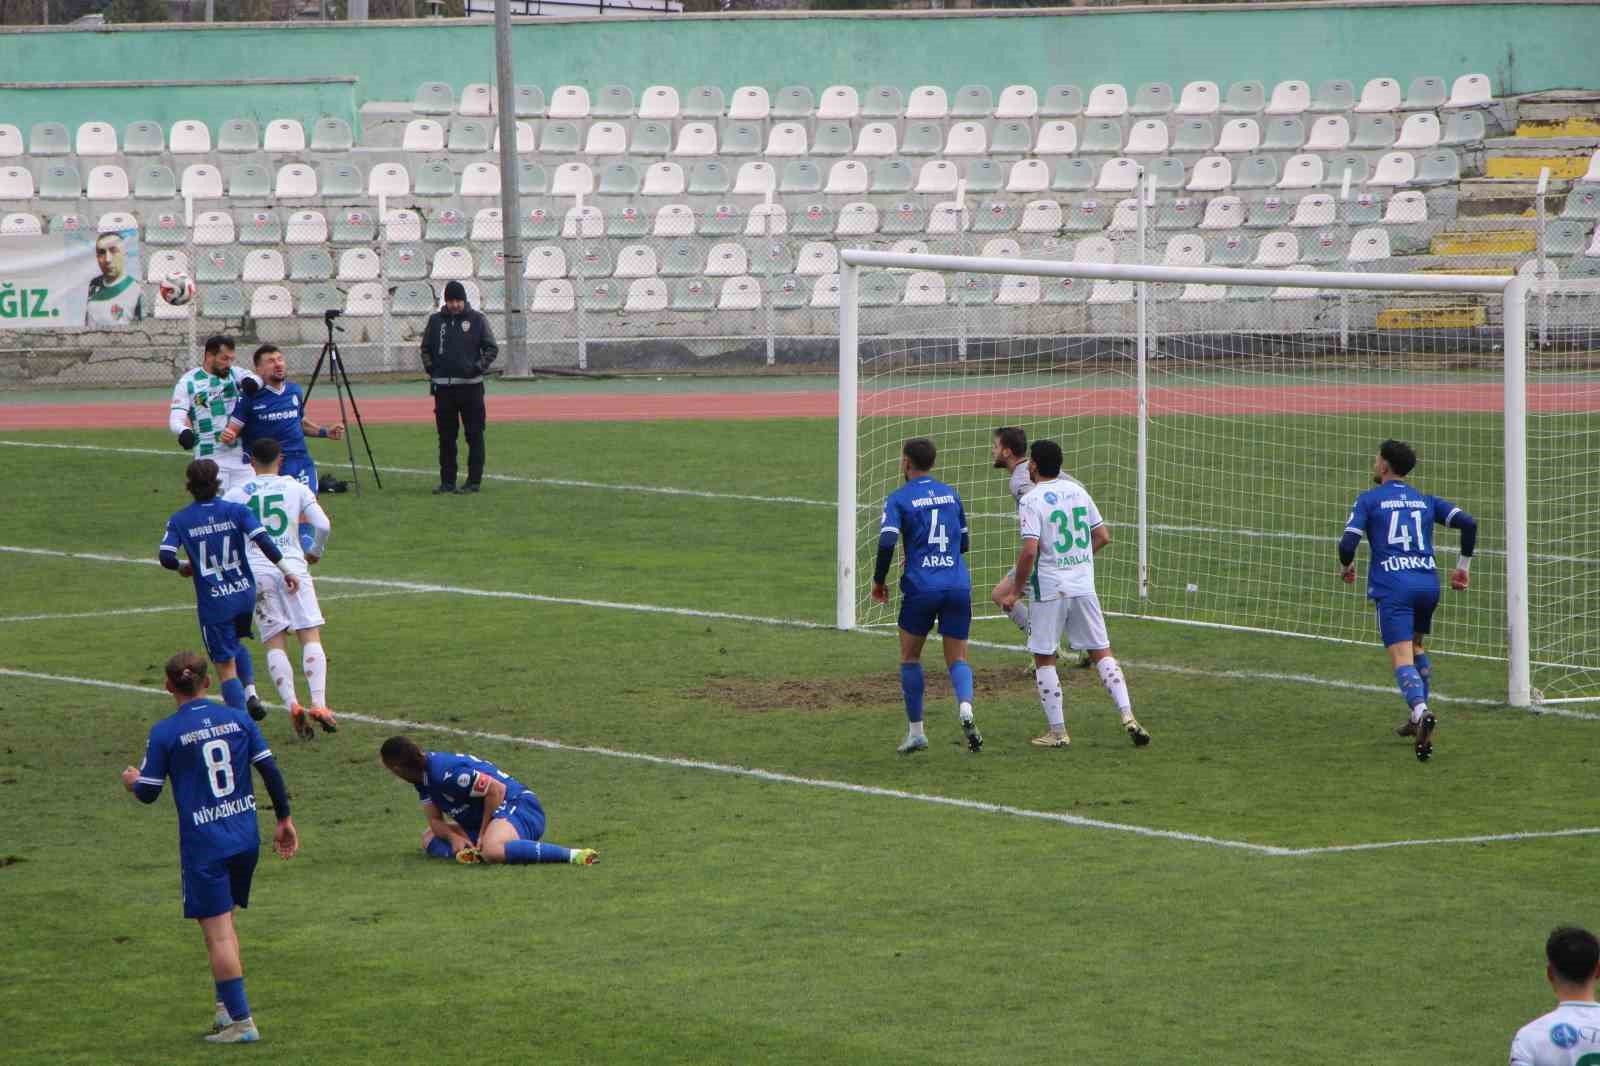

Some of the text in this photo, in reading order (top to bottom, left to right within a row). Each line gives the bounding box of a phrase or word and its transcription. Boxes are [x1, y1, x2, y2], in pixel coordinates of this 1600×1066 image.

[247, 494, 289, 537] 15
[928, 508, 949, 553] 4
[1049, 506, 1090, 554] 35
[1387, 510, 1425, 552] 41
[199, 535, 242, 581] 44
[921, 555, 954, 568] ARAS
[202, 739, 236, 798] 8
